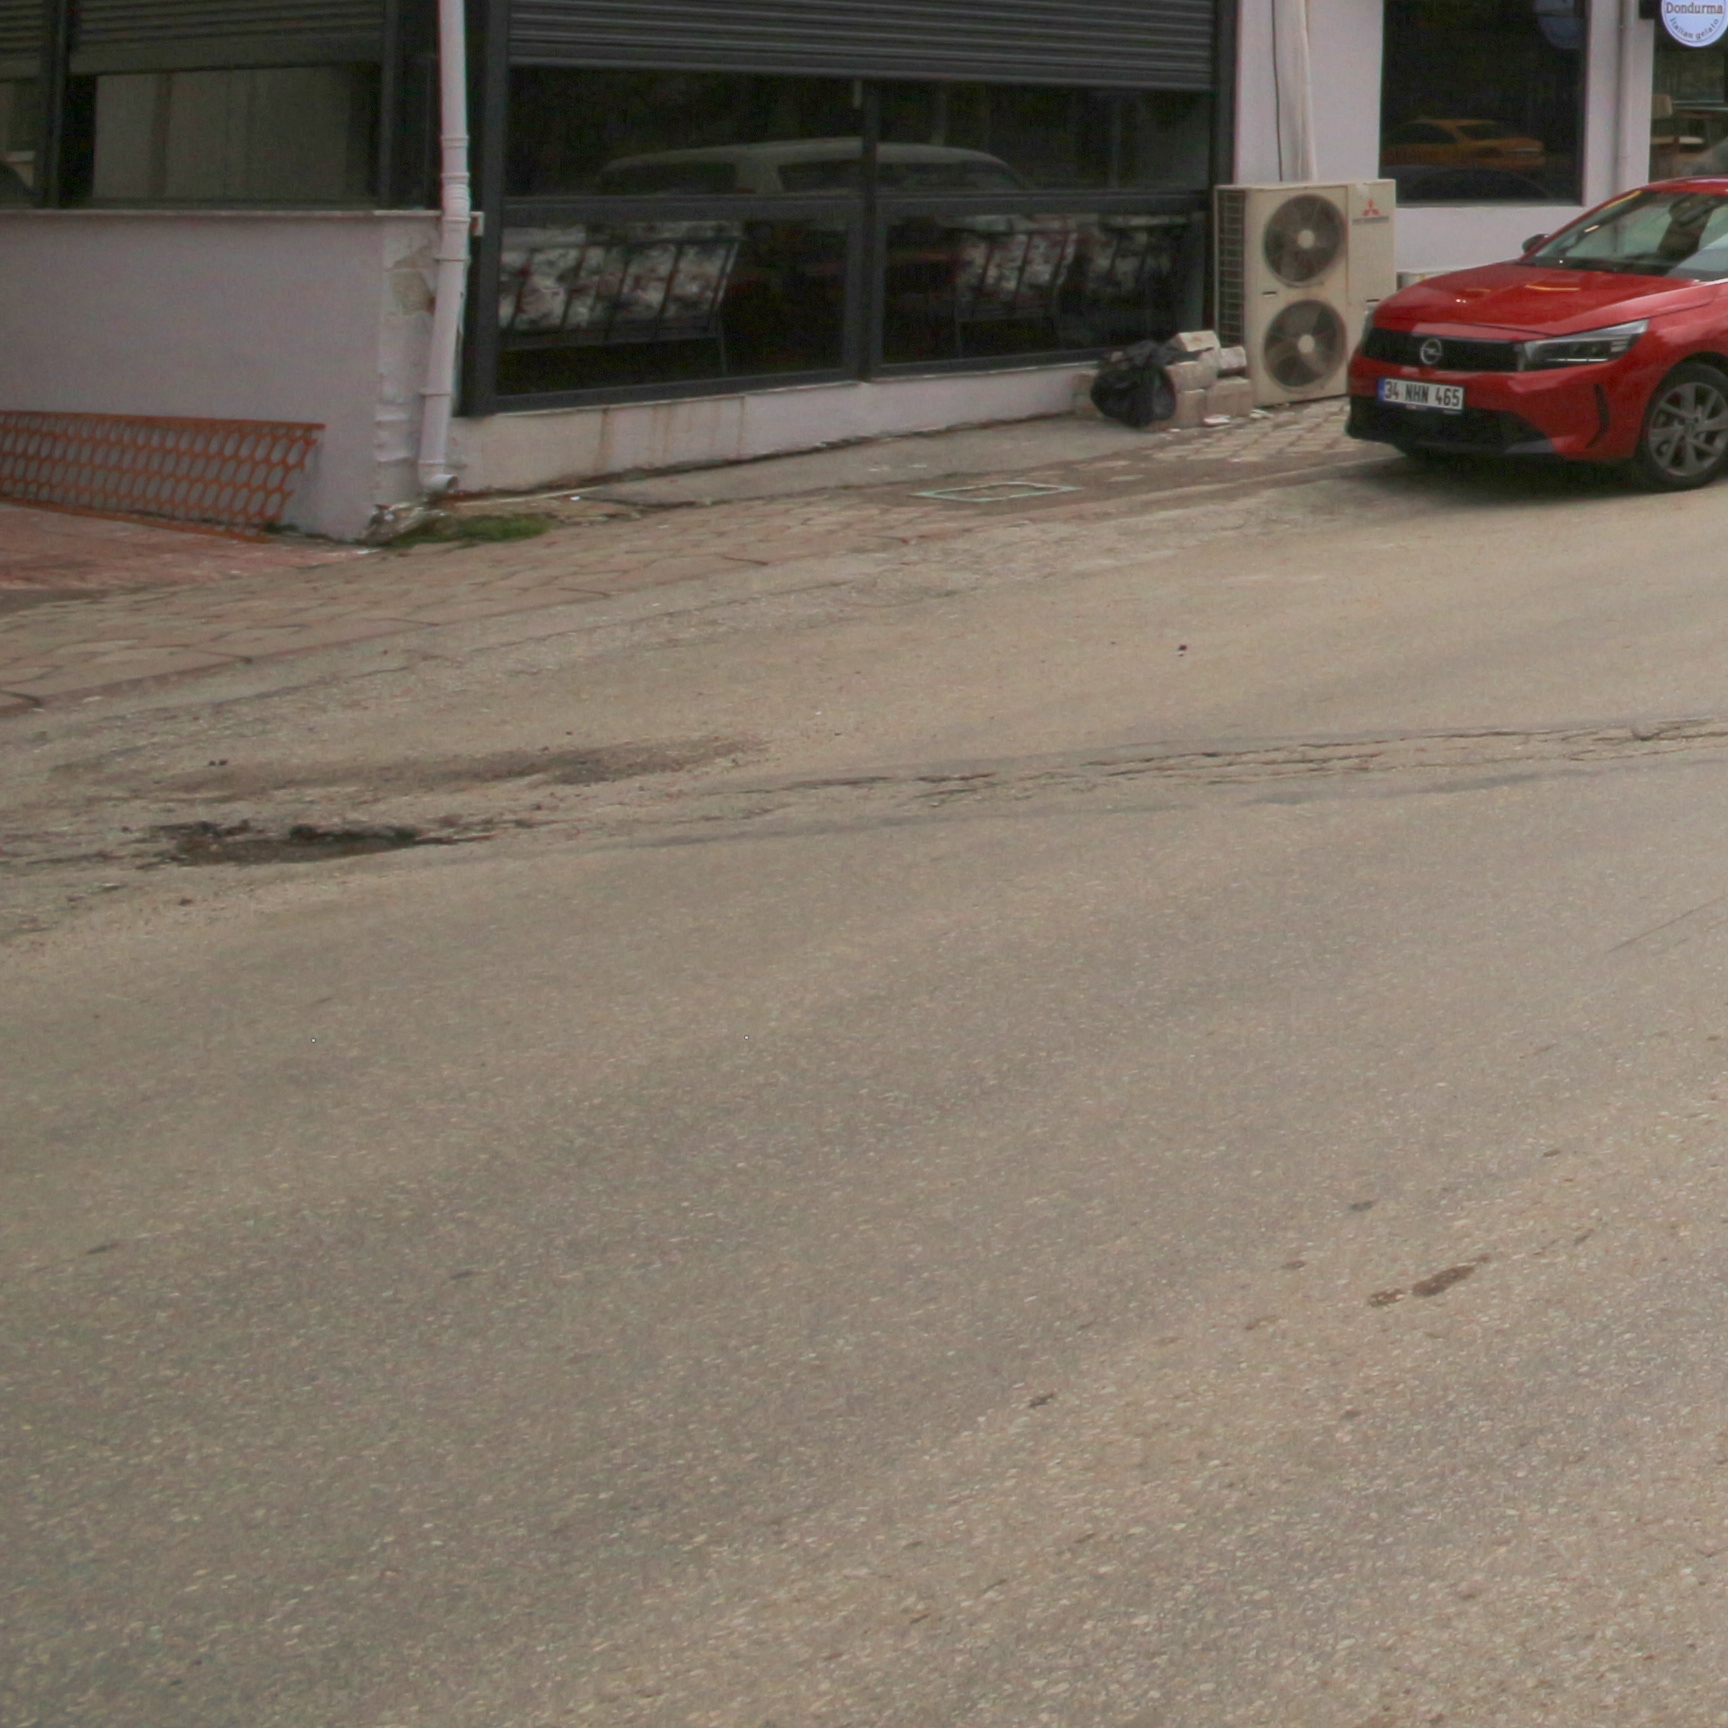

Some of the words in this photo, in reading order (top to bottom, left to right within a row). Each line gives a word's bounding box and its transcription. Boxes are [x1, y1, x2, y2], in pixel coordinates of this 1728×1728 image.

[1666, 2, 1723, 14] Dondurma
[1385, 380, 1399, 401] 34
[1405, 381, 1429, 404] NHN
[1435, 384, 1461, 407] 465
